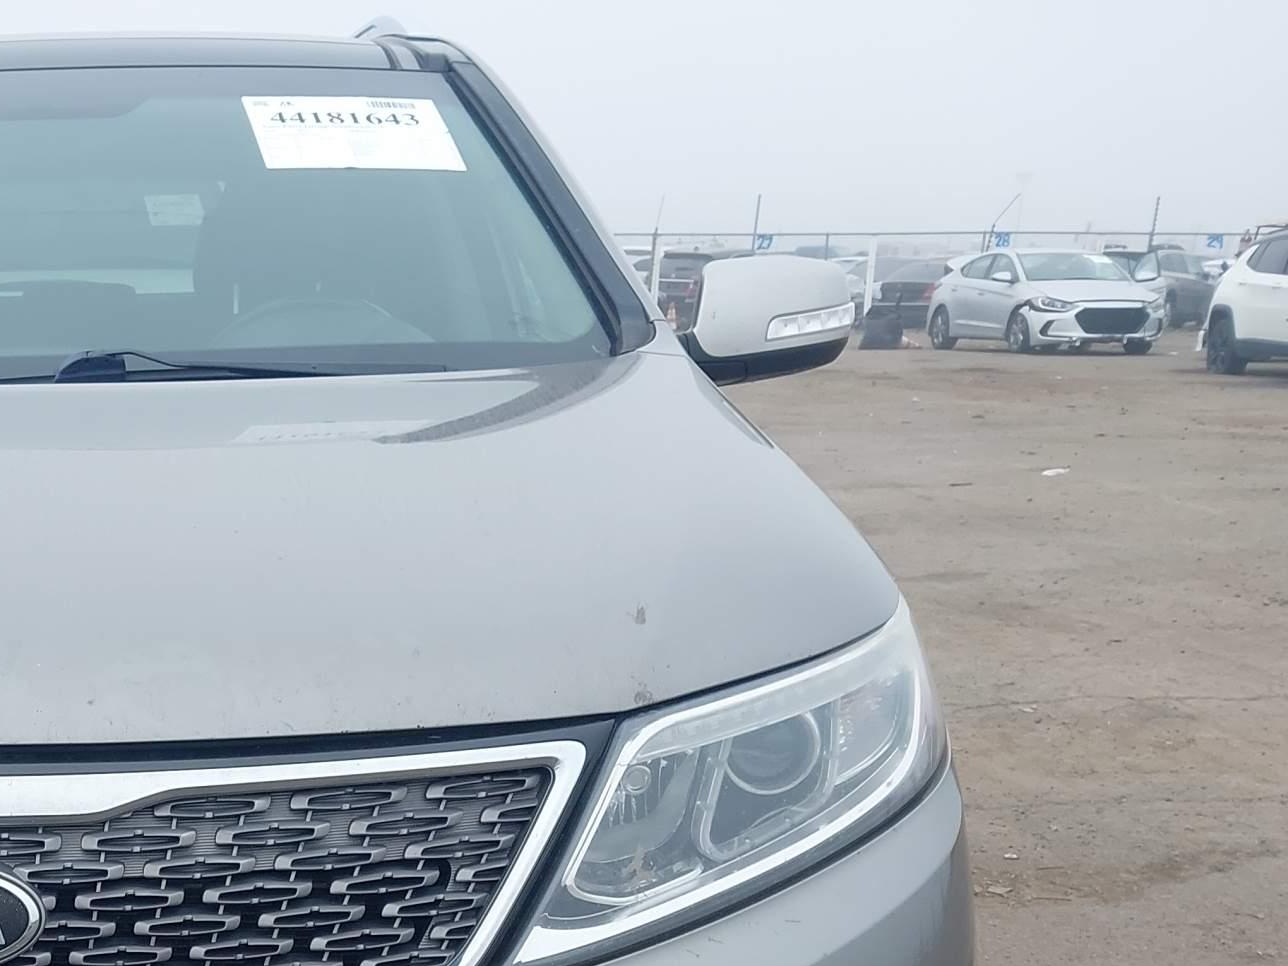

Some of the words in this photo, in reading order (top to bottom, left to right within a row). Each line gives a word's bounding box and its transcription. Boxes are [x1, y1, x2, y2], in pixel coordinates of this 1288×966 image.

[270, 111, 420, 126] 44181643
[994, 232, 1010, 248] 28
[1207, 234, 1224, 249] 29
